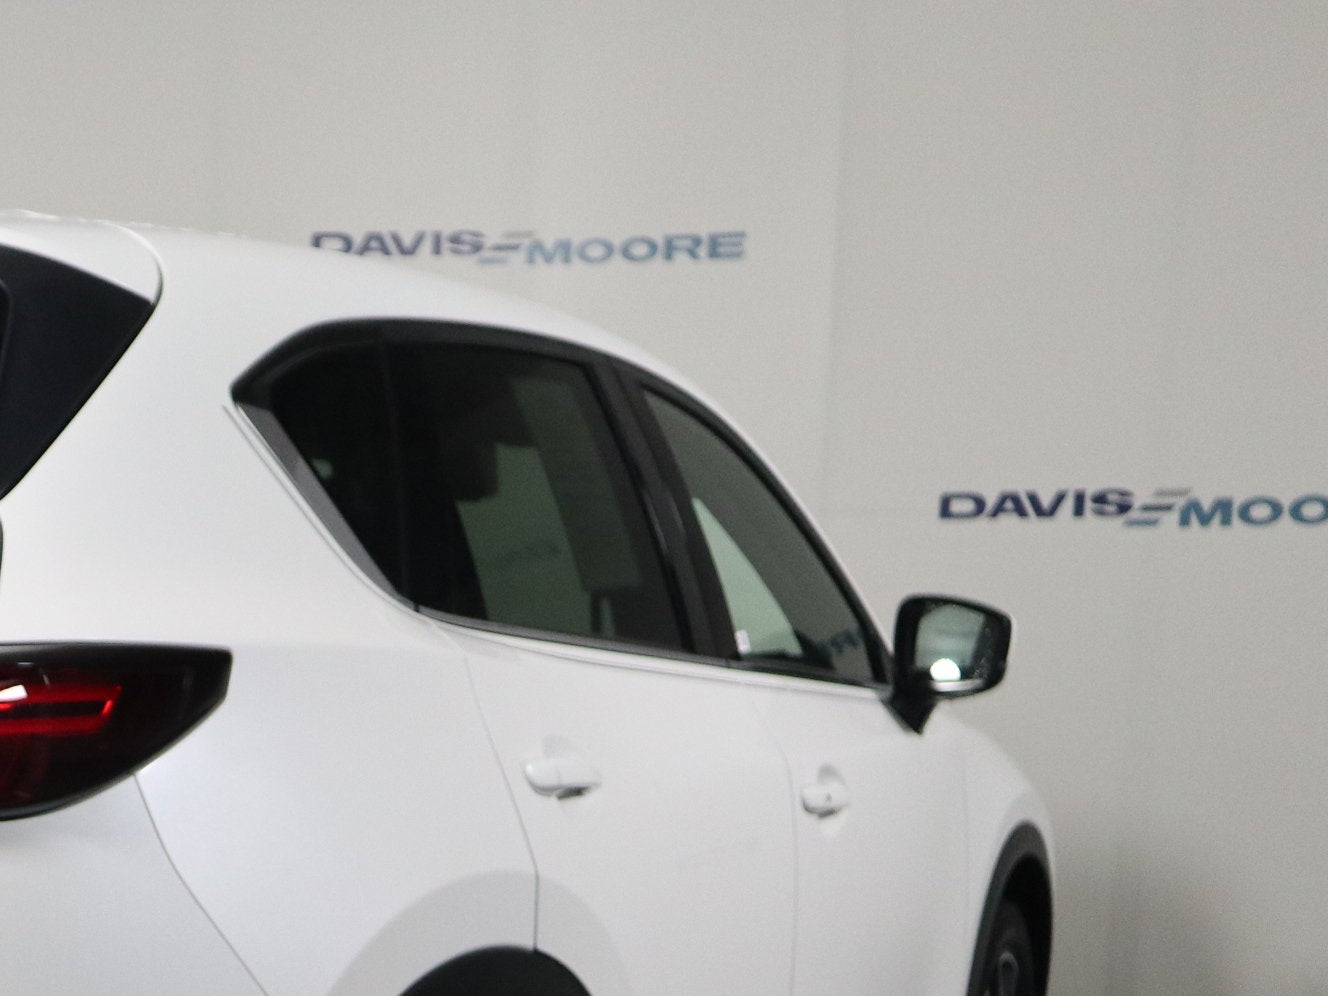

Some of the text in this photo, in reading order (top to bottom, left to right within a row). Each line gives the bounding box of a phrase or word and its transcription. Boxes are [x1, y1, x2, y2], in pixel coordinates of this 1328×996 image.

[311, 230, 746, 264] DAVIS MOORE
[938, 487, 1328, 527] DAVIS MOO
